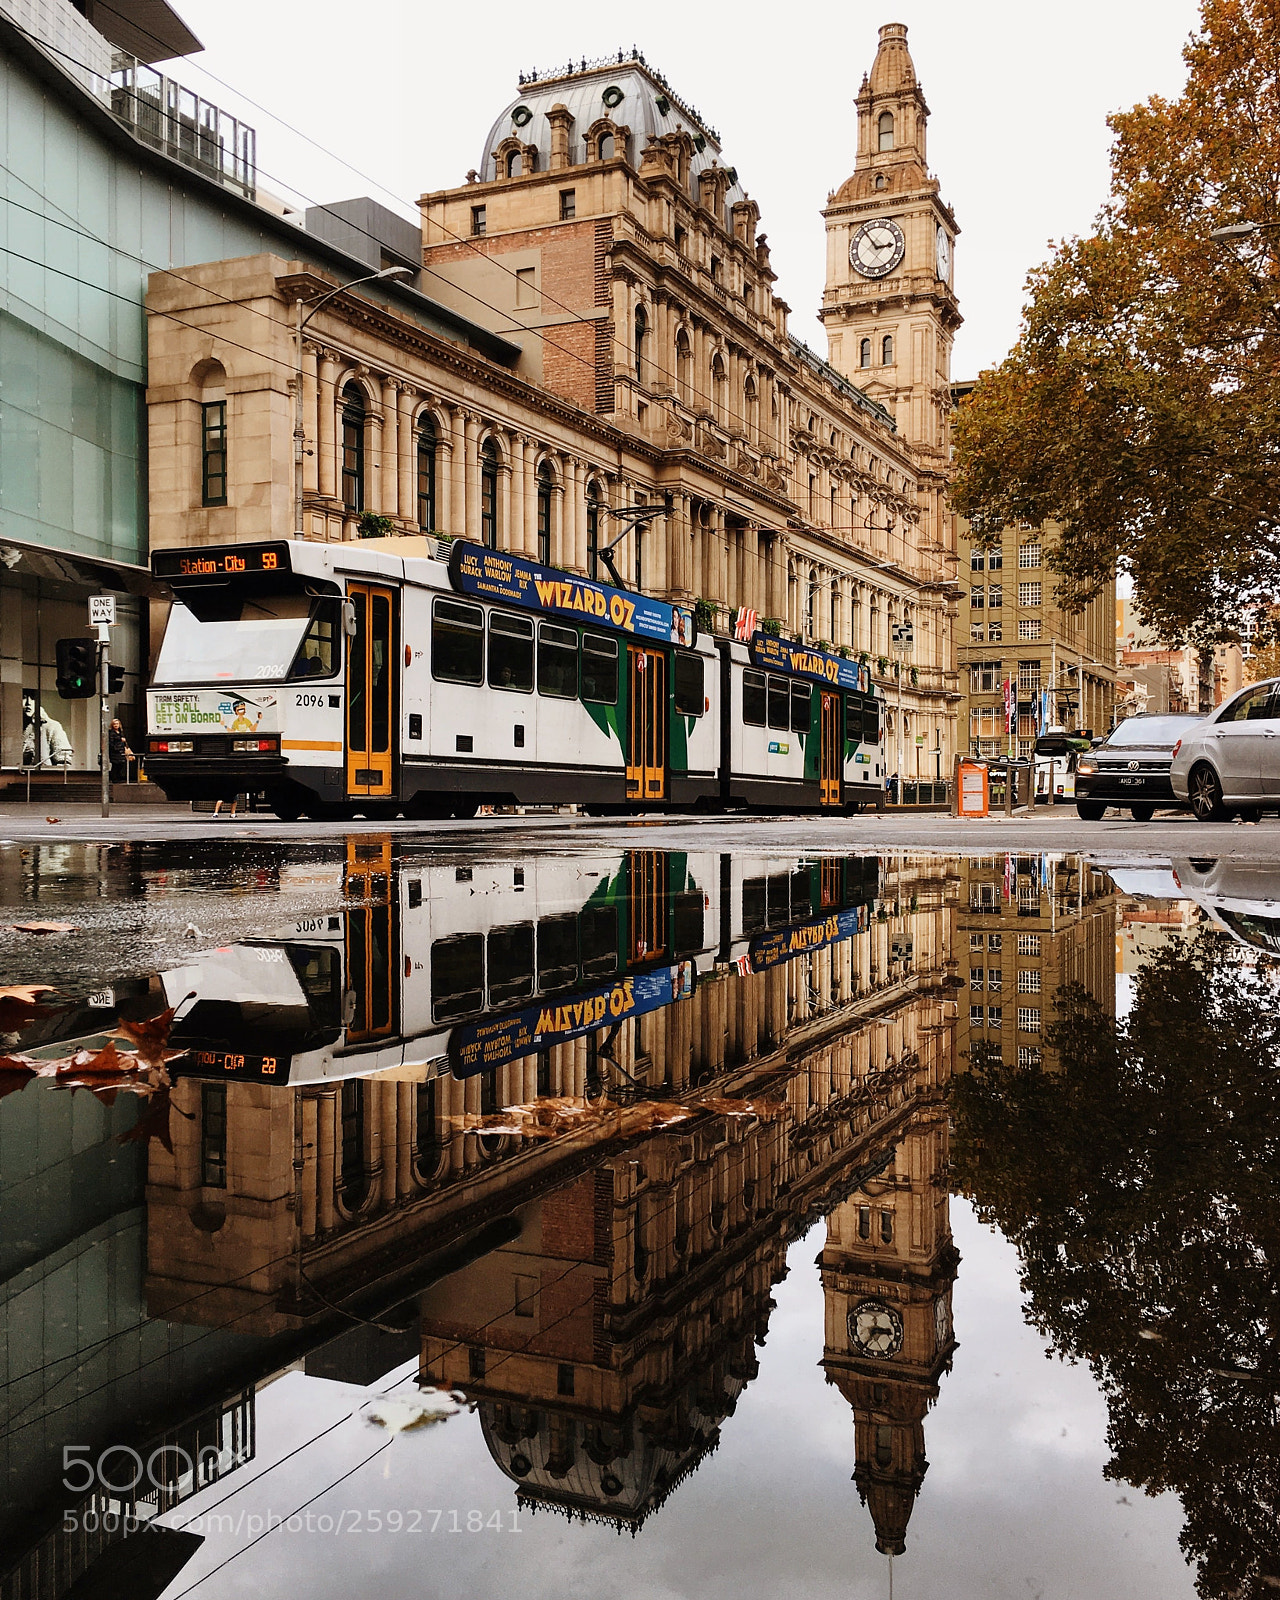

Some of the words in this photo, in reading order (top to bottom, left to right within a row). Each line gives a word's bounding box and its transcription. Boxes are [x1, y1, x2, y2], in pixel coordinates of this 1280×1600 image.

[262, 552, 277, 569] 59
[464, 554, 478, 566] LUCY
[484, 556, 512, 572] ANTHONY
[460, 563, 482, 578] DURACK
[484, 566, 512, 582] WARLOW
[534, 580, 607, 617] WIZARD
[610, 594, 635, 632] OZ
[255, 664, 284, 678] 2096
[790, 652, 824, 676] WIZARD
[826, 659, 840, 684] OZ
[156, 703, 180, 712] LET'S
[183, 703, 200, 712] ALL
[296, 694, 324, 707] 2096
[156, 714, 173, 724] GET
[176, 714, 188, 724] ON
[190, 713, 220, 723] BOARD
